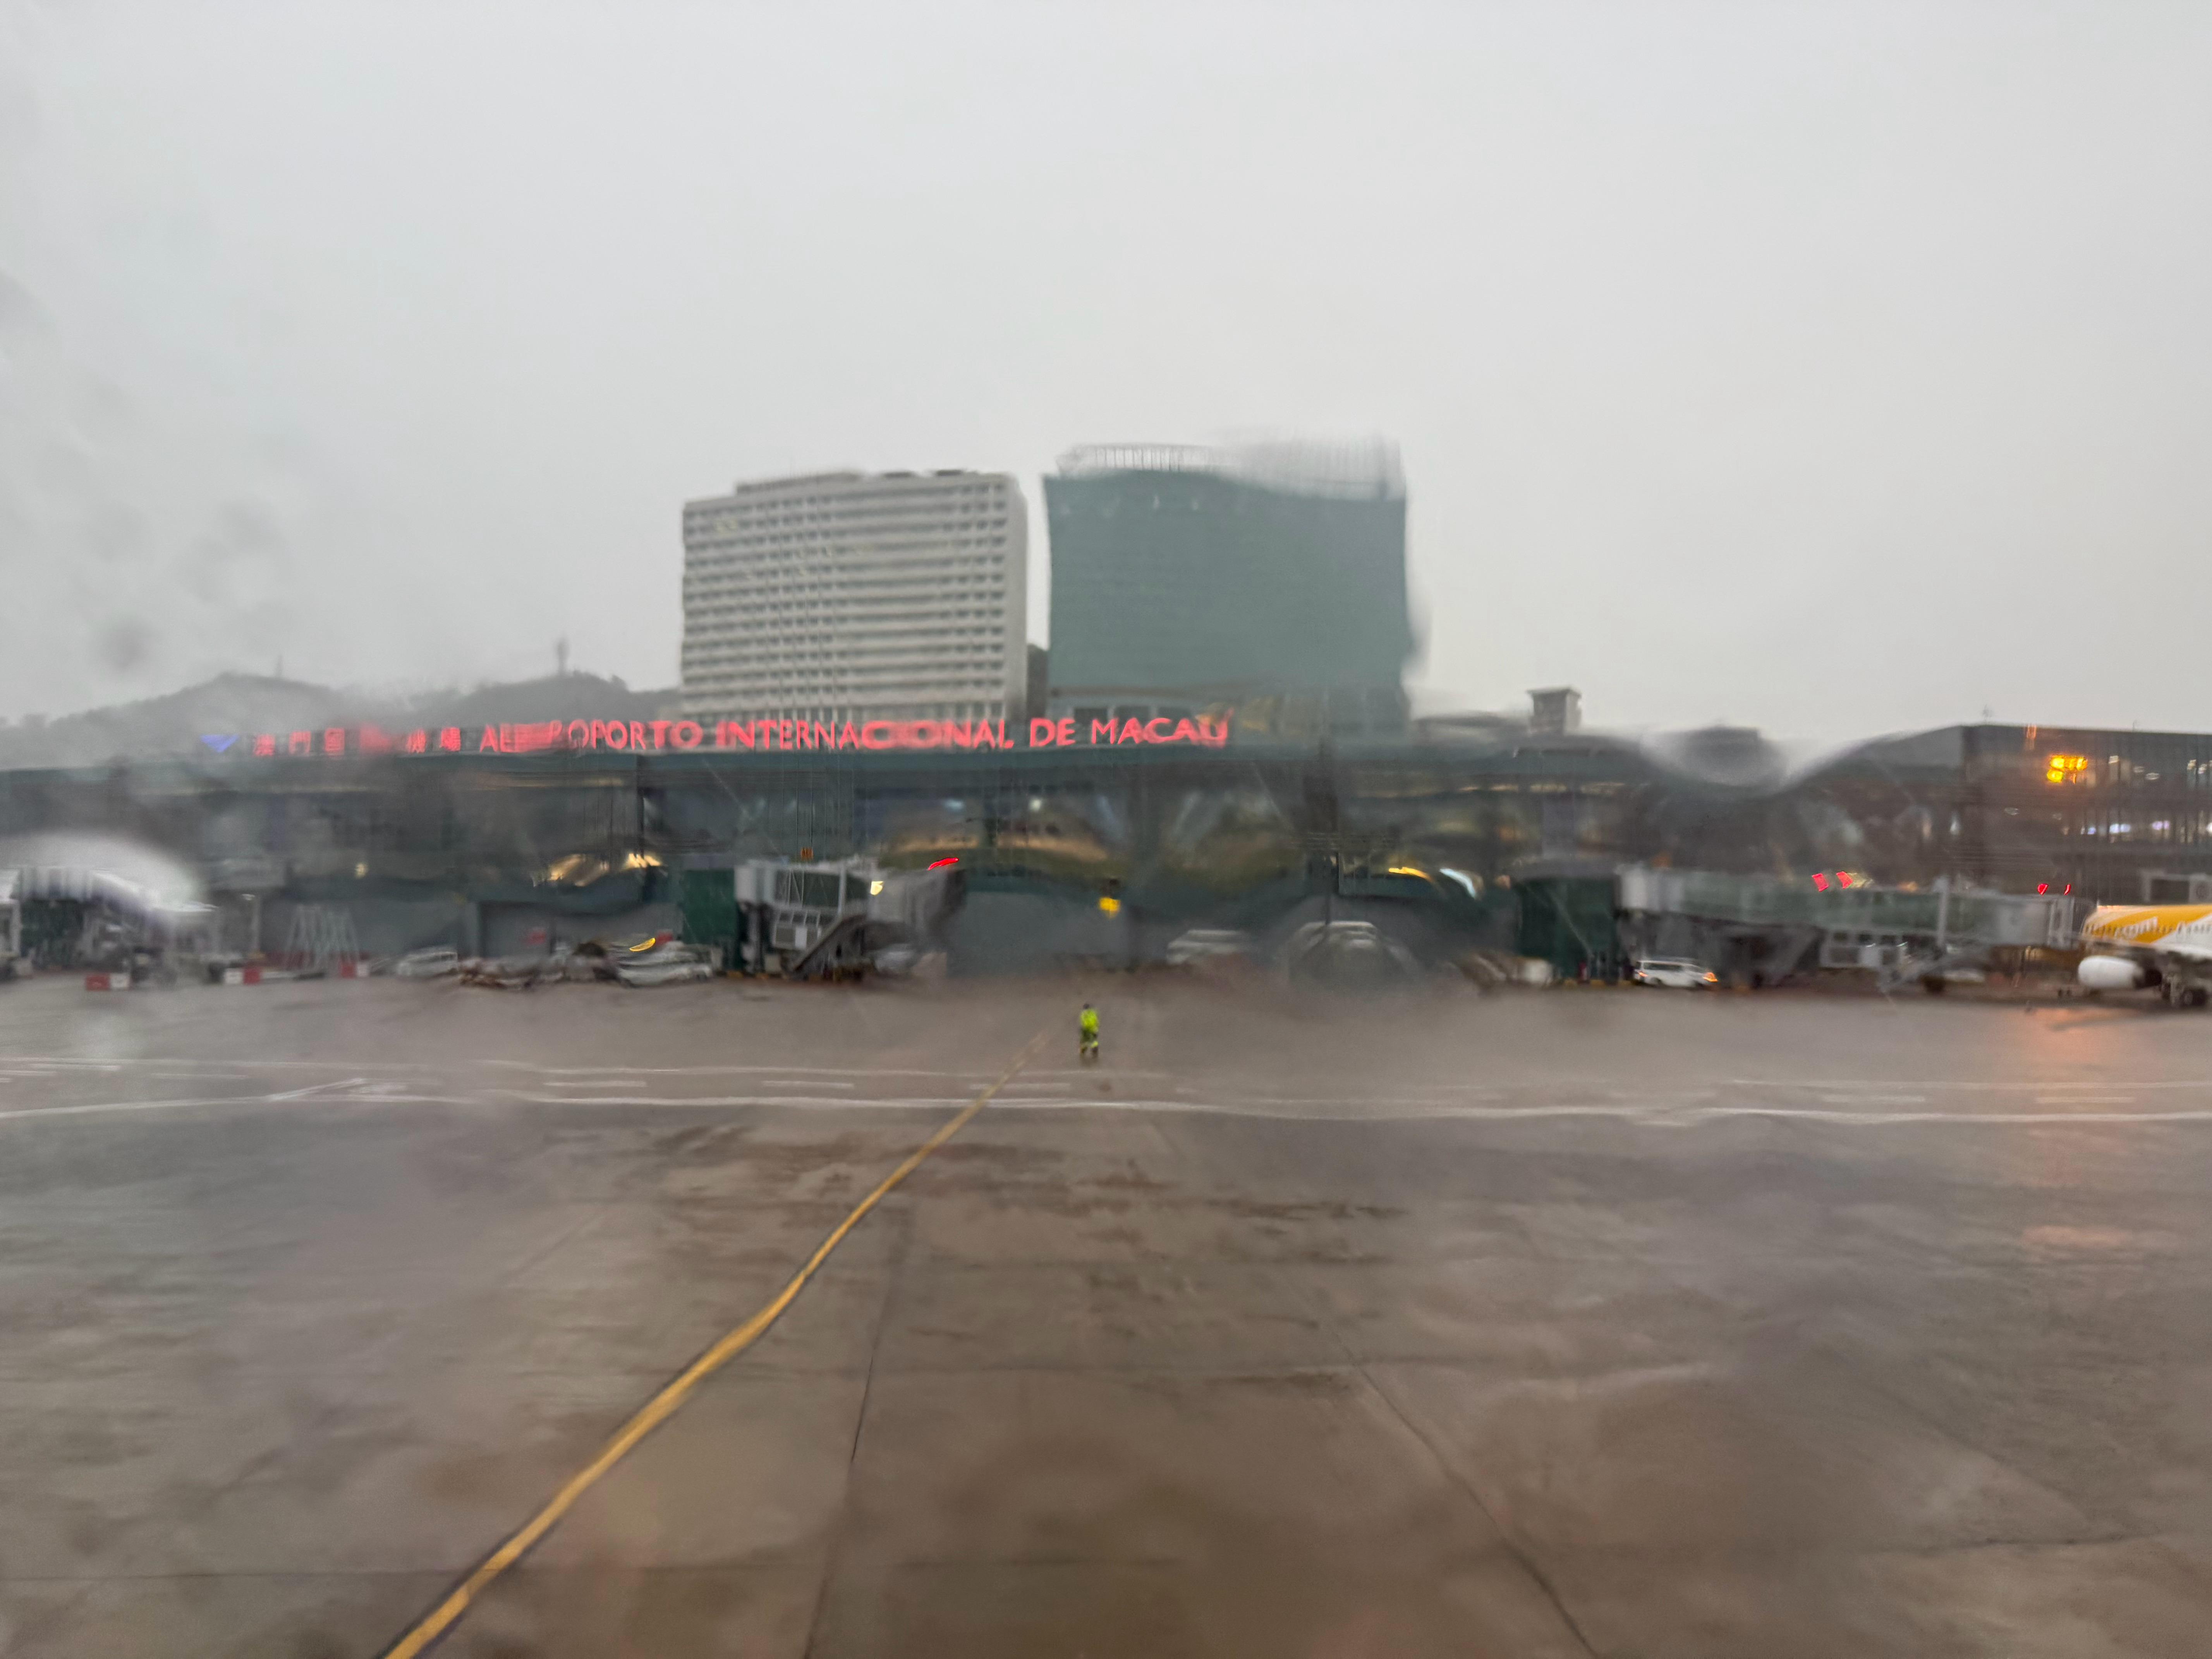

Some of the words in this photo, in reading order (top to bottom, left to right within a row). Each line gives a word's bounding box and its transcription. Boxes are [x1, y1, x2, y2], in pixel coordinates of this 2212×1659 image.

[479, 720, 703, 753] AEOPORTO
[715, 719, 1015, 750] INTERNACONAL
[1030, 718, 1076, 747] DE
[1091, 709, 1232, 747] MACAU
